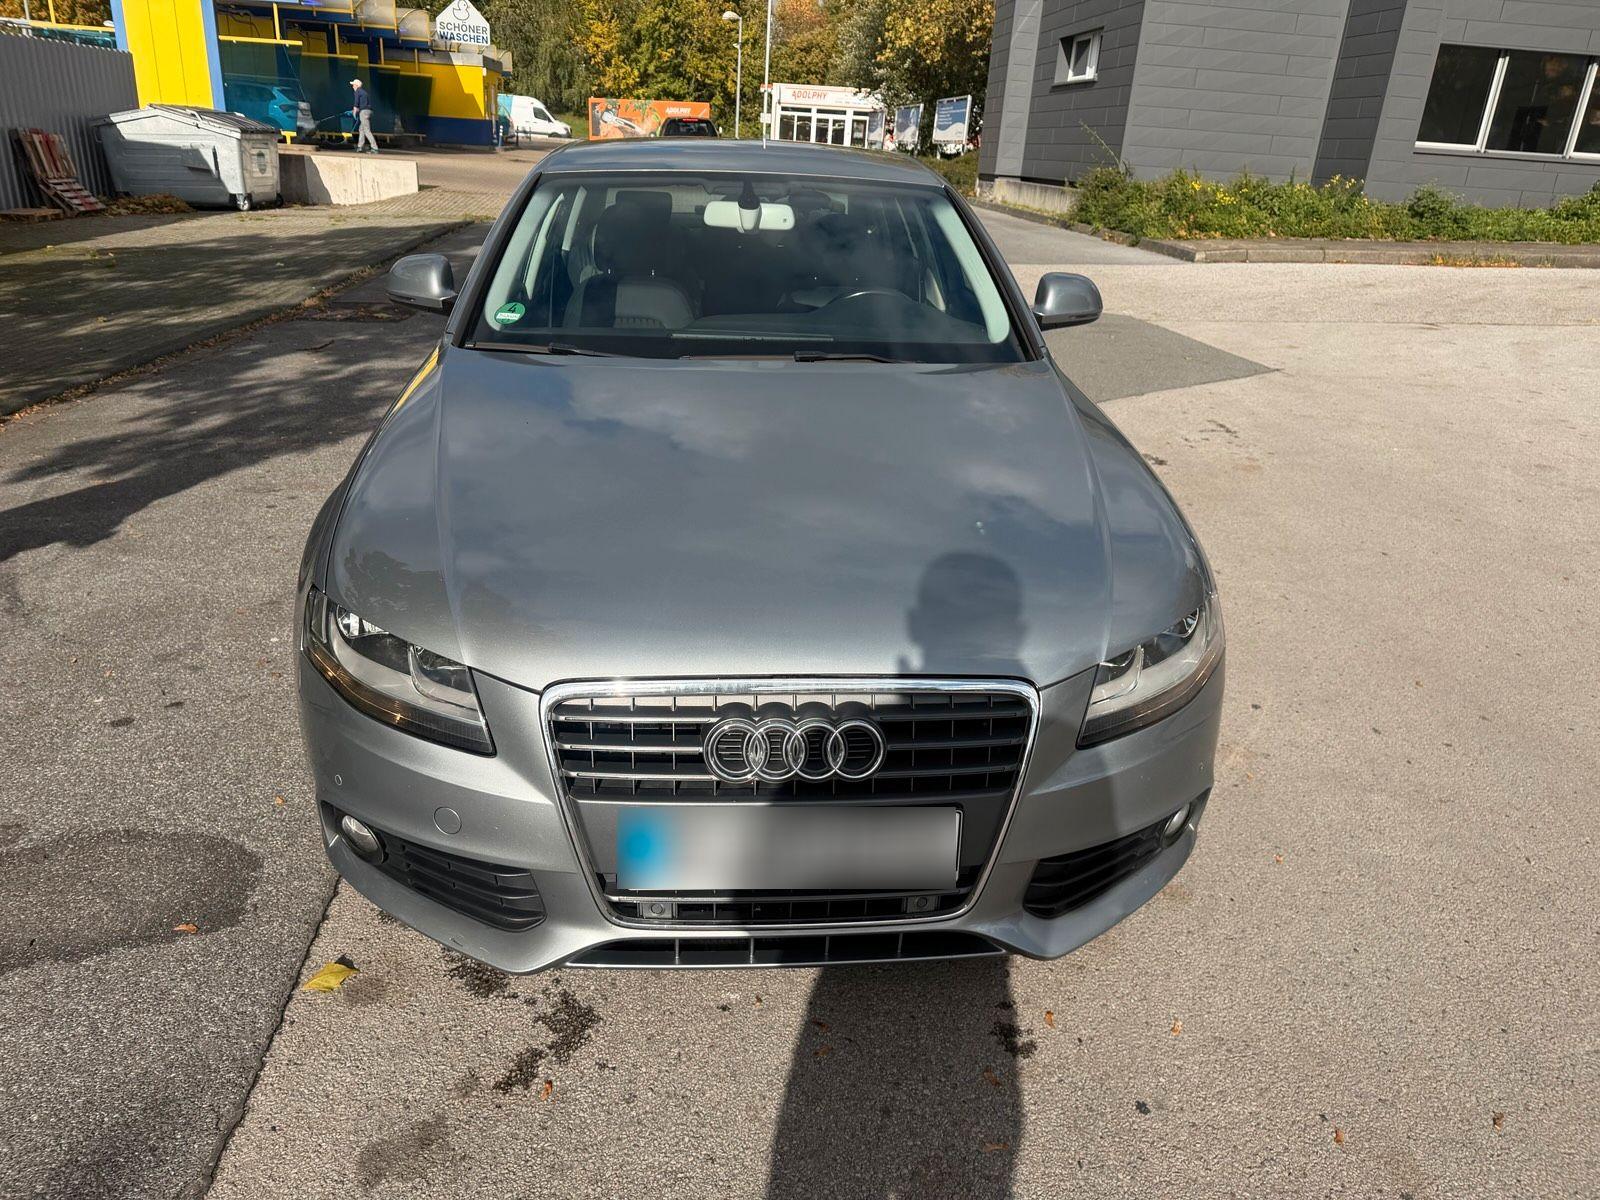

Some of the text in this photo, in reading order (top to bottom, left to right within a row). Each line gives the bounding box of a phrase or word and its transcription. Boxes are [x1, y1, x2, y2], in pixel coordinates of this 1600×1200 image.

[439, 21, 488, 35] SCHÖNER
[439, 31, 489, 44] WASCHEN
[791, 90, 828, 101] ADOLPHY
[508, 303, 518, 313] 4
